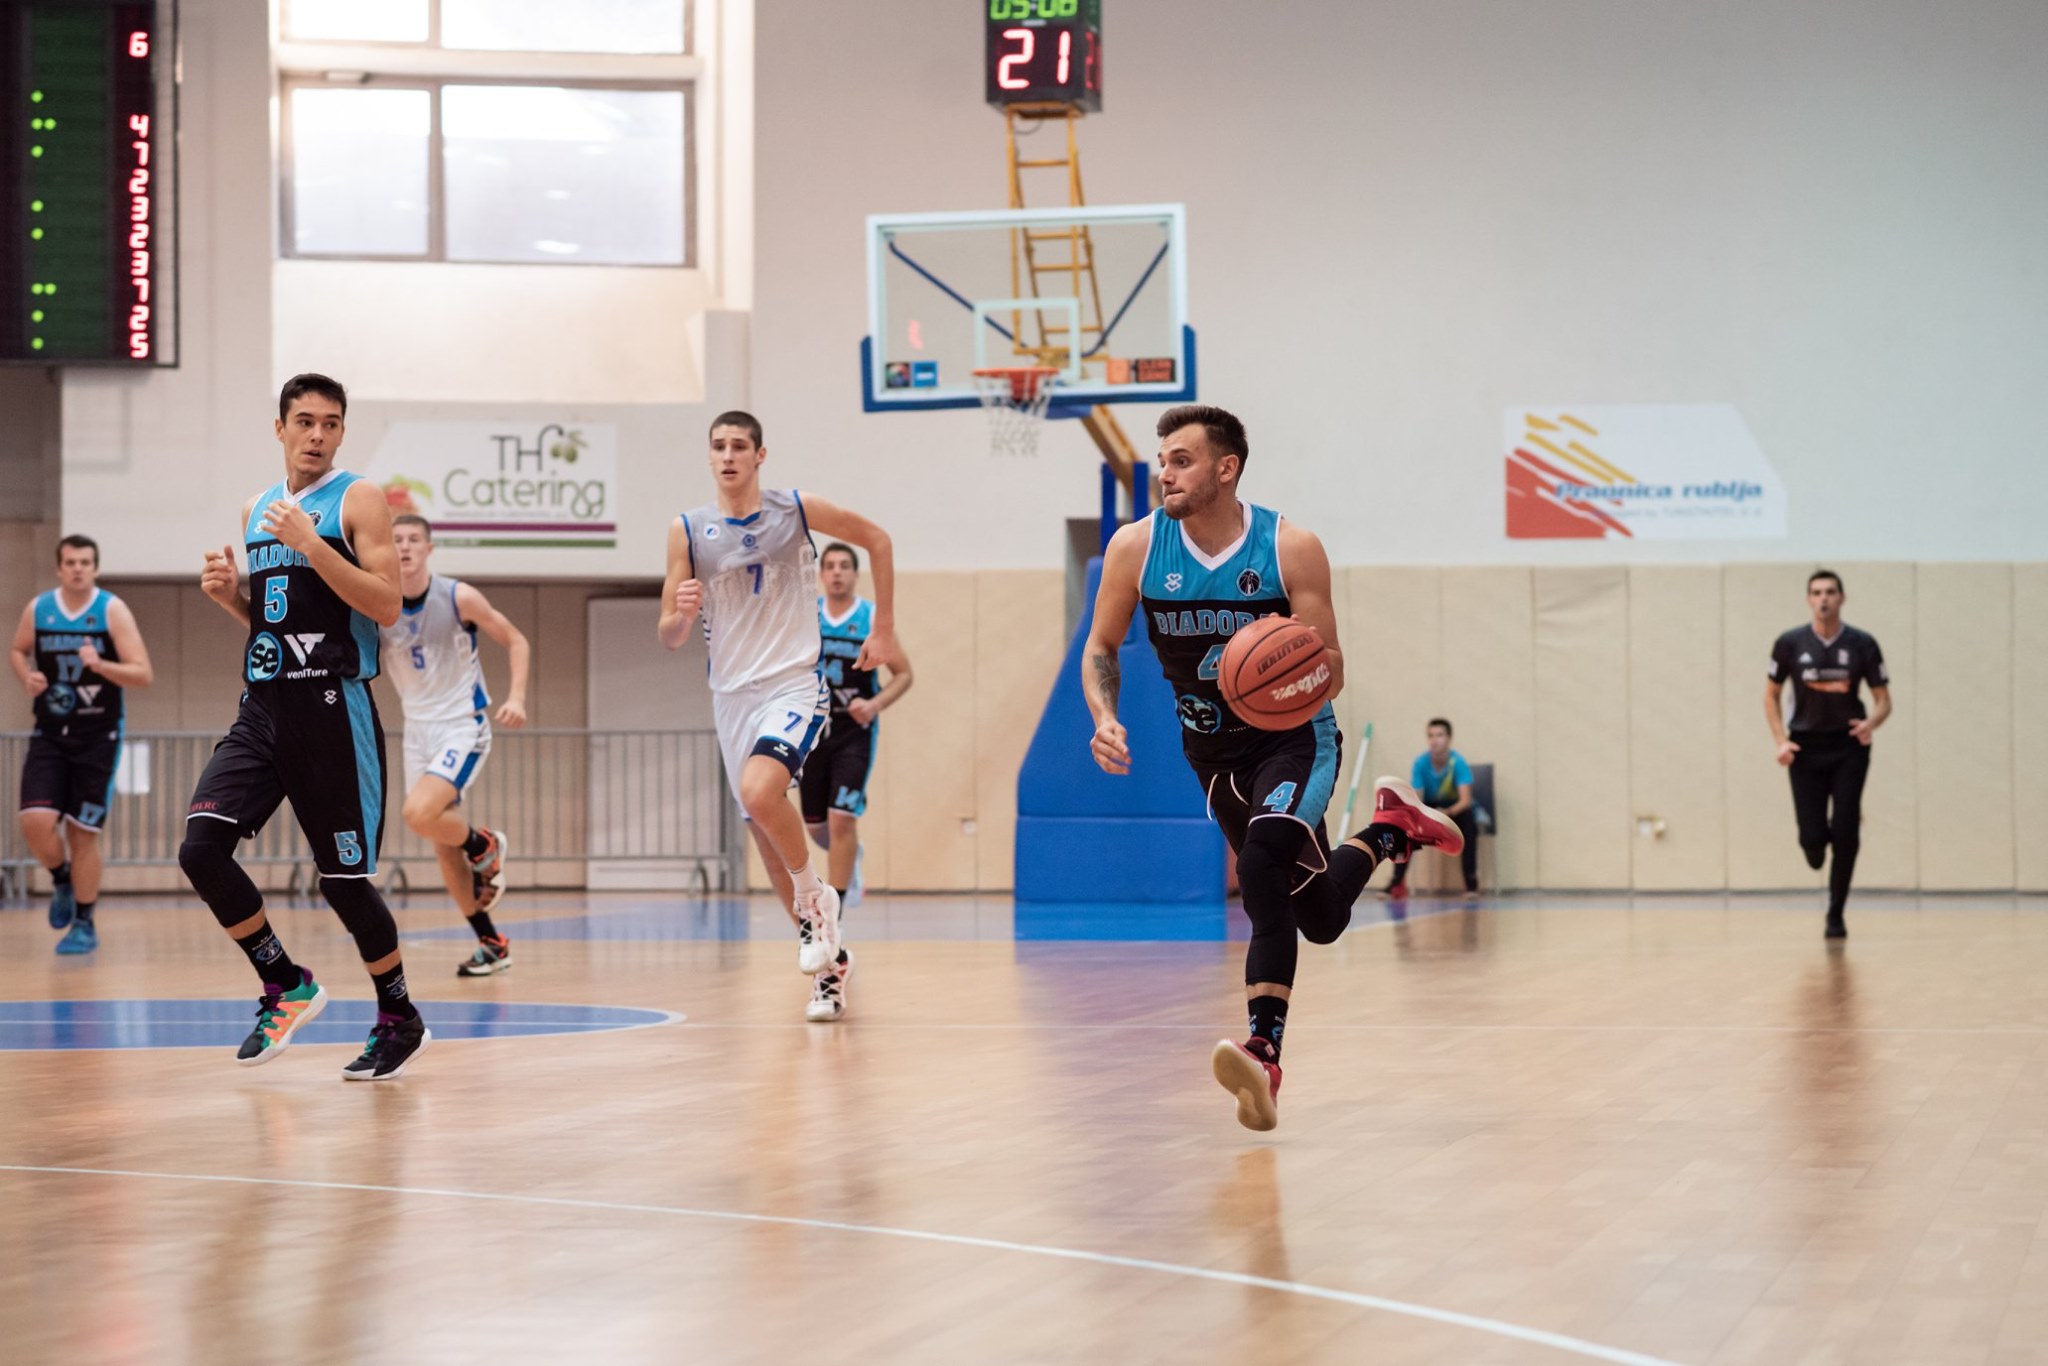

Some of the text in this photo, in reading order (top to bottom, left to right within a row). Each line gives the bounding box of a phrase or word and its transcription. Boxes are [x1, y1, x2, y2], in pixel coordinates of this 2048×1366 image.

[129, 31, 149, 57] 6
[997, 28, 1071, 89] 21
[129, 114, 149, 139] 4
[132, 141, 149, 166] 7
[129, 169, 149, 194] 2
[131, 196, 149, 221] 3
[129, 223, 149, 249] 2
[131, 250, 149, 276] 3
[132, 278, 149, 303] 7
[129, 305, 149, 331] 2
[130, 332, 149, 359] 5
[443, 468, 606, 519] Catering
[1682, 480, 1763, 503] rublja
[747, 563, 763, 594] 7
[264, 575, 288, 623] 5
[1153, 609, 1270, 636] DIADOR
[411, 645, 426, 669] 5
[784, 711, 803, 734] 7
[442, 748, 459, 769] 5
[1262, 781, 1298, 813] 4
[334, 830, 362, 866] 5
